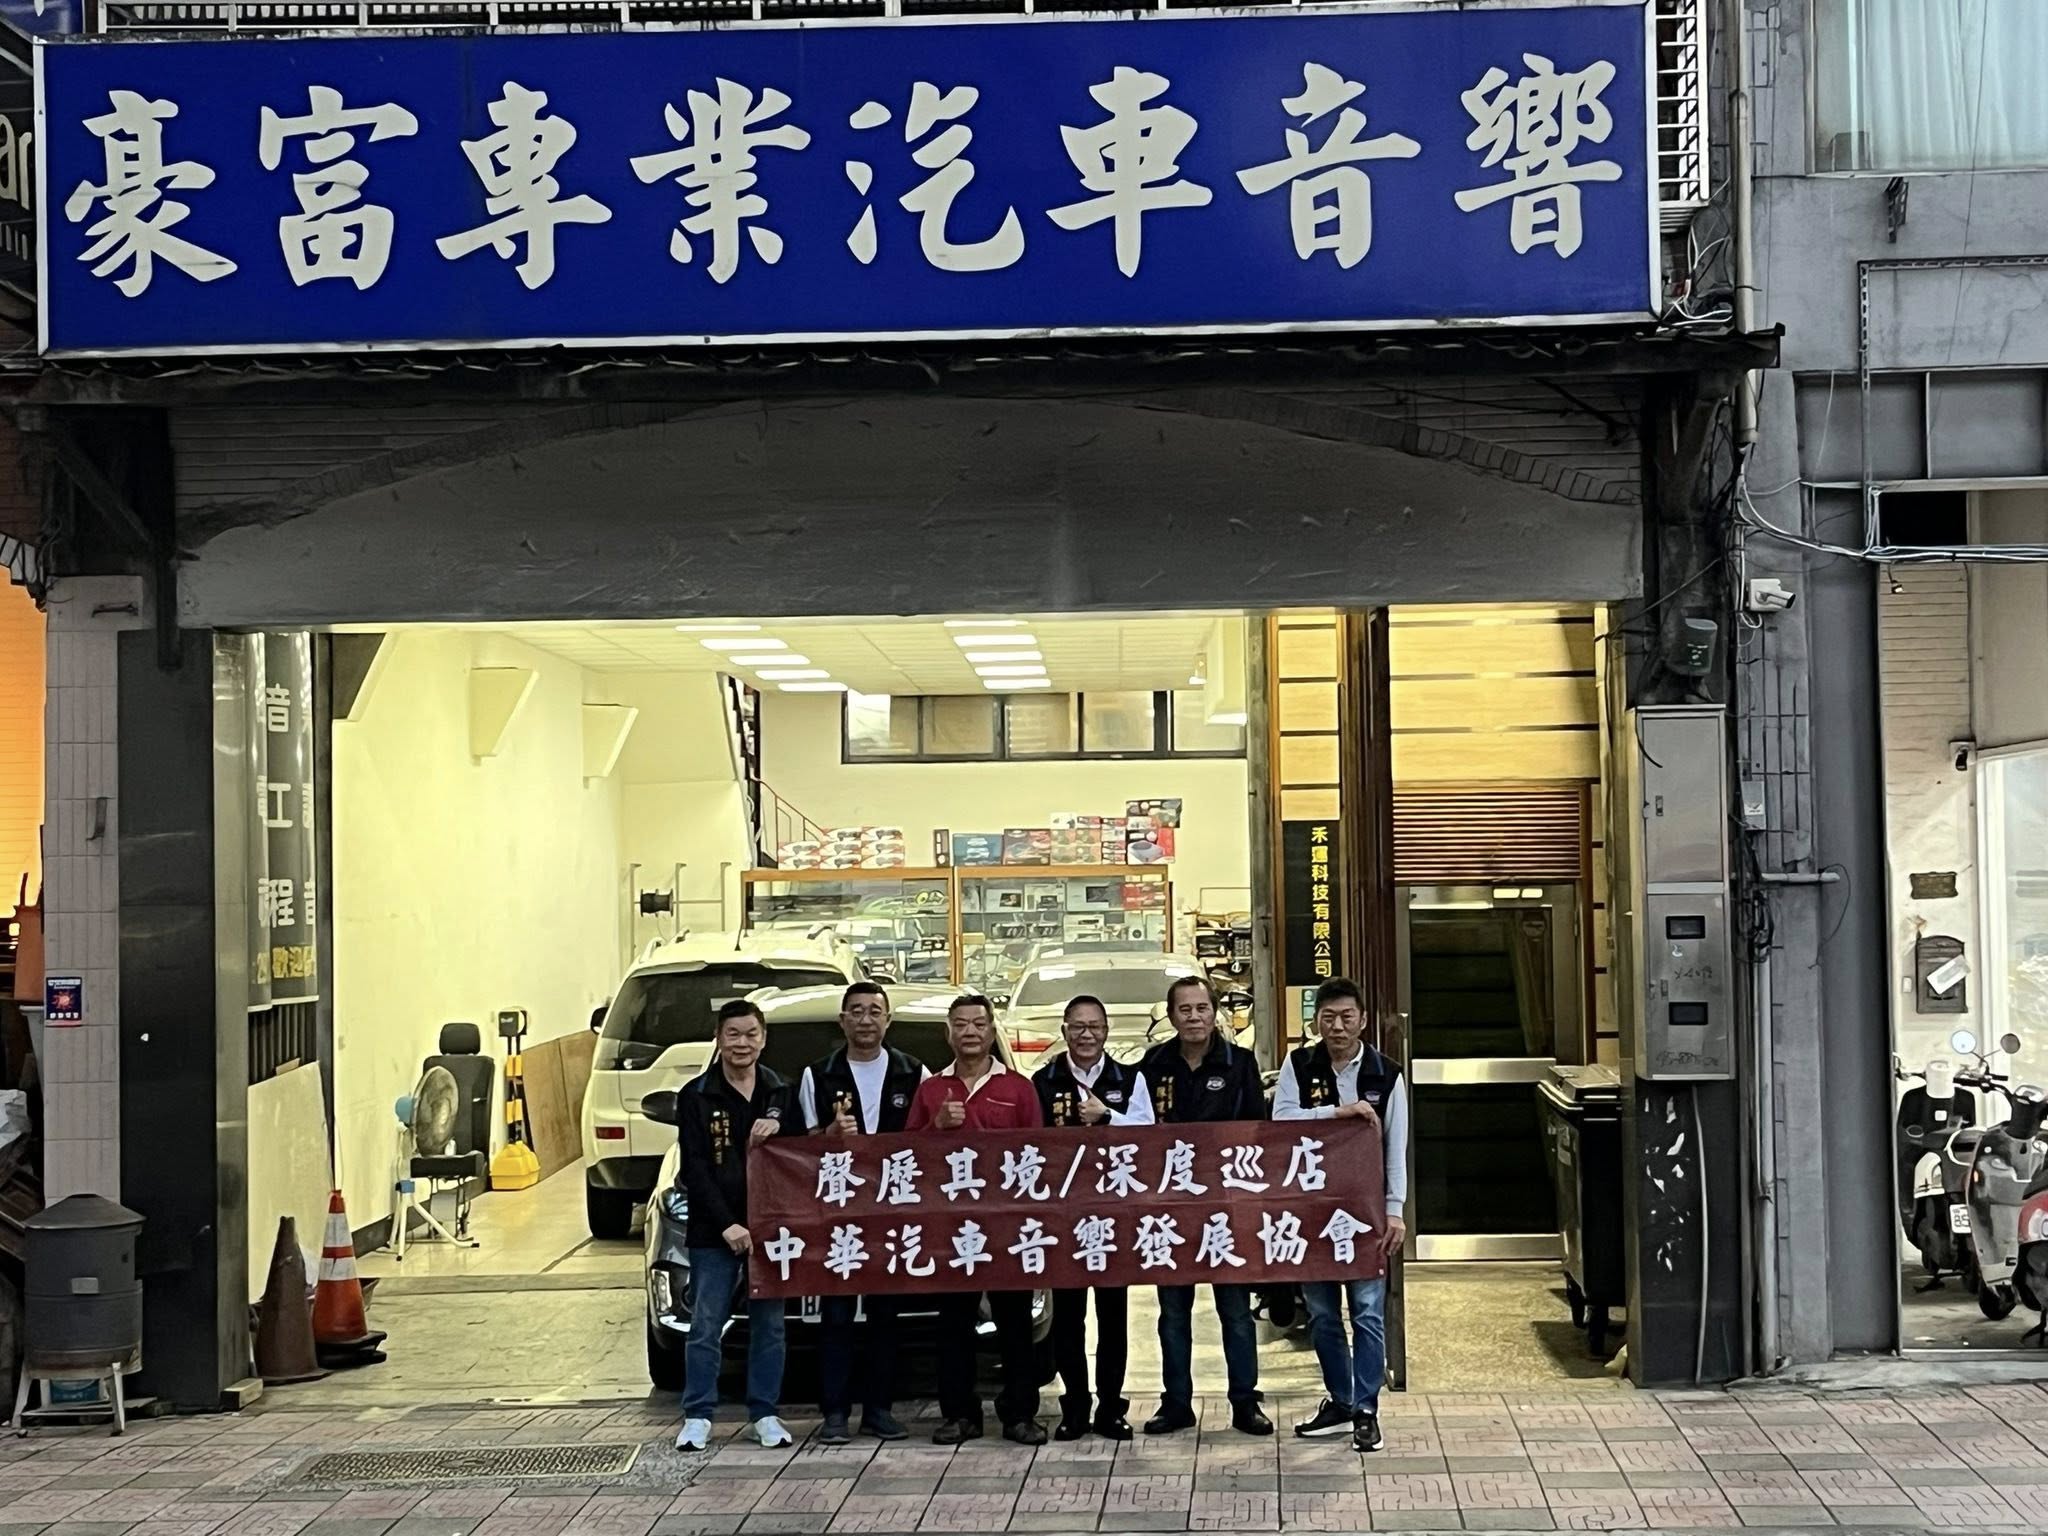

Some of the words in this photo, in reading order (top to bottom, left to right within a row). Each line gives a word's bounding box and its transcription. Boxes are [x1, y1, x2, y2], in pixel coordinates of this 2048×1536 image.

[64, 52, 1623, 298] 豪富專業汽車音響
[815, 1136, 1328, 1206] 聲歷其境/深度巡店
[764, 1208, 1372, 1281] 中華汽車音響發展協會
